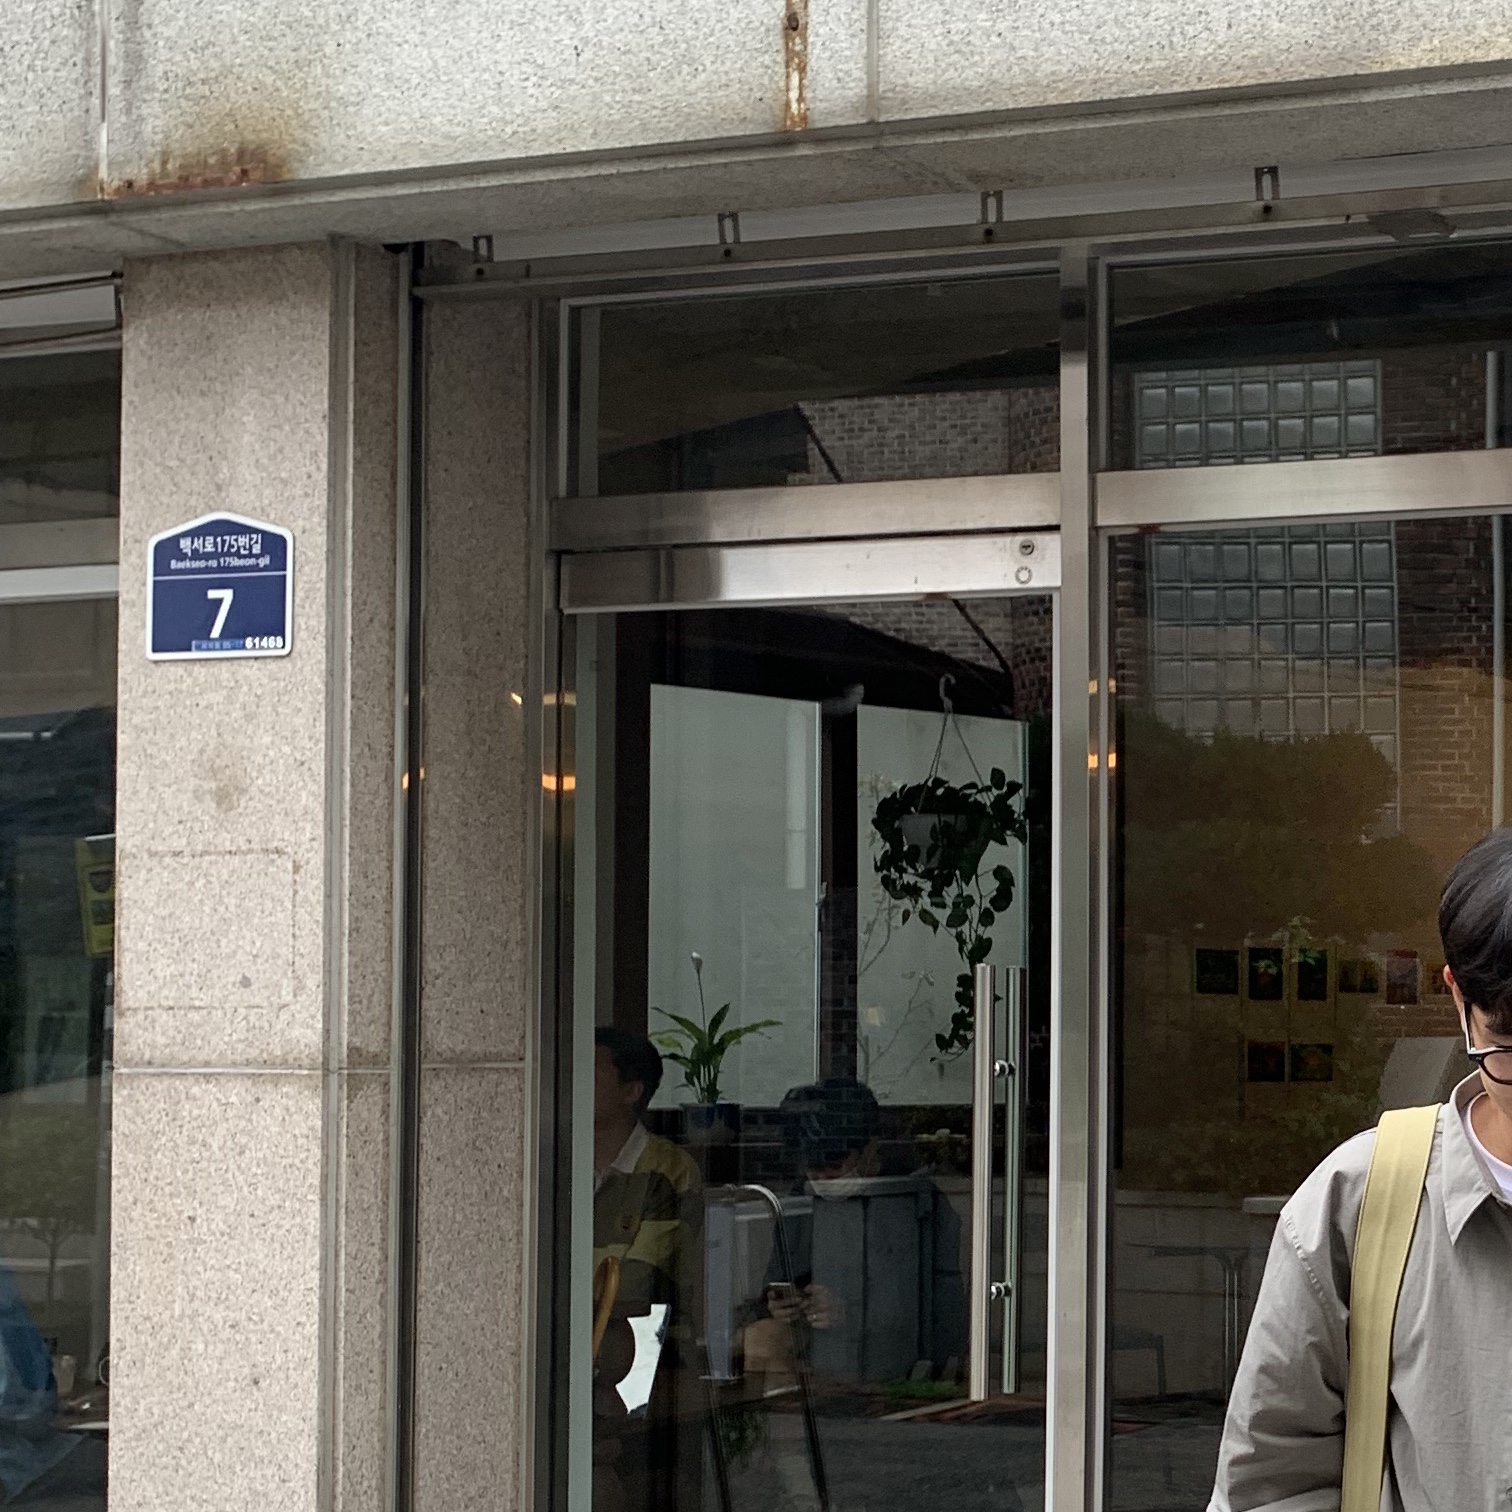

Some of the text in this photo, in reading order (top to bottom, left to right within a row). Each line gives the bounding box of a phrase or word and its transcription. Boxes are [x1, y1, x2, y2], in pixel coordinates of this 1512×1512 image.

[180, 533, 262, 557] 백서로175번길
[170, 559, 218, 570] Baekseo-ro
[207, 588, 234, 639] 7
[245, 635, 284, 649] 61468
